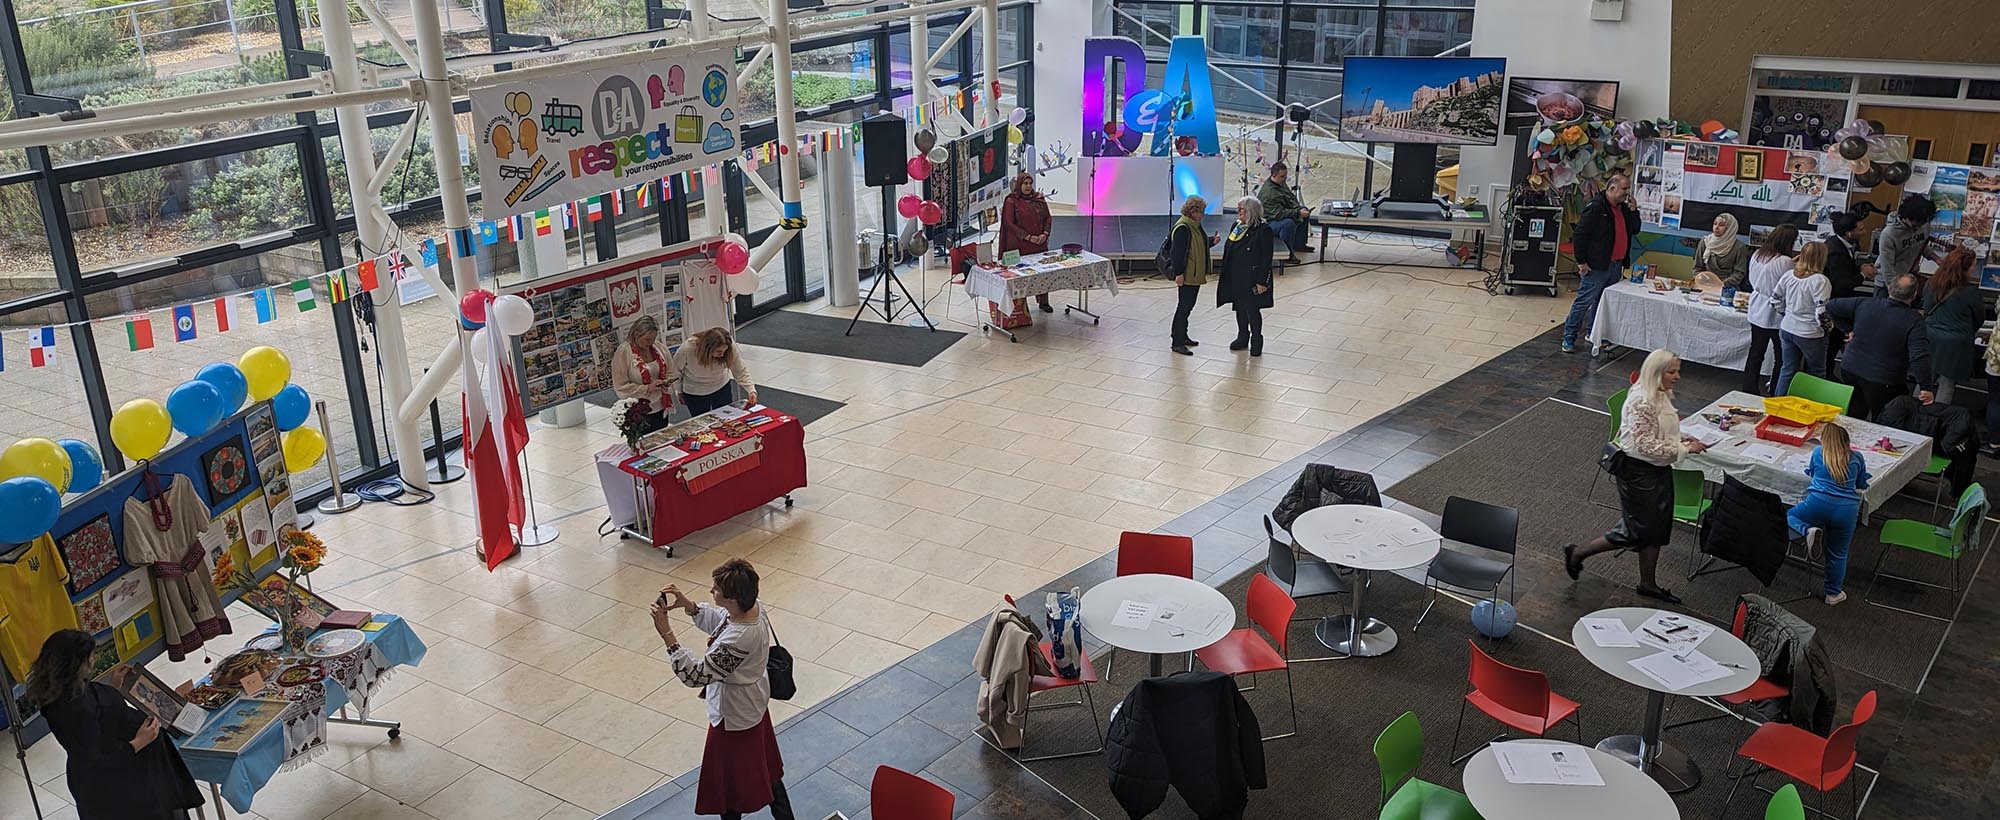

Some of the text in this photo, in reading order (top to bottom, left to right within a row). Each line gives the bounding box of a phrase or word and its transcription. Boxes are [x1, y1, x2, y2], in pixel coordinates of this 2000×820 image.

[599, 86, 639, 136] D&A
[663, 99, 680, 107] Equality
[683, 95, 700, 103] Diversity
[484, 115, 513, 144] Relationships
[568, 122, 673, 179] respect
[543, 161, 561, 177] Spaces
[625, 152, 694, 177] your responsibilities
[699, 447, 745, 473] POLSKA
